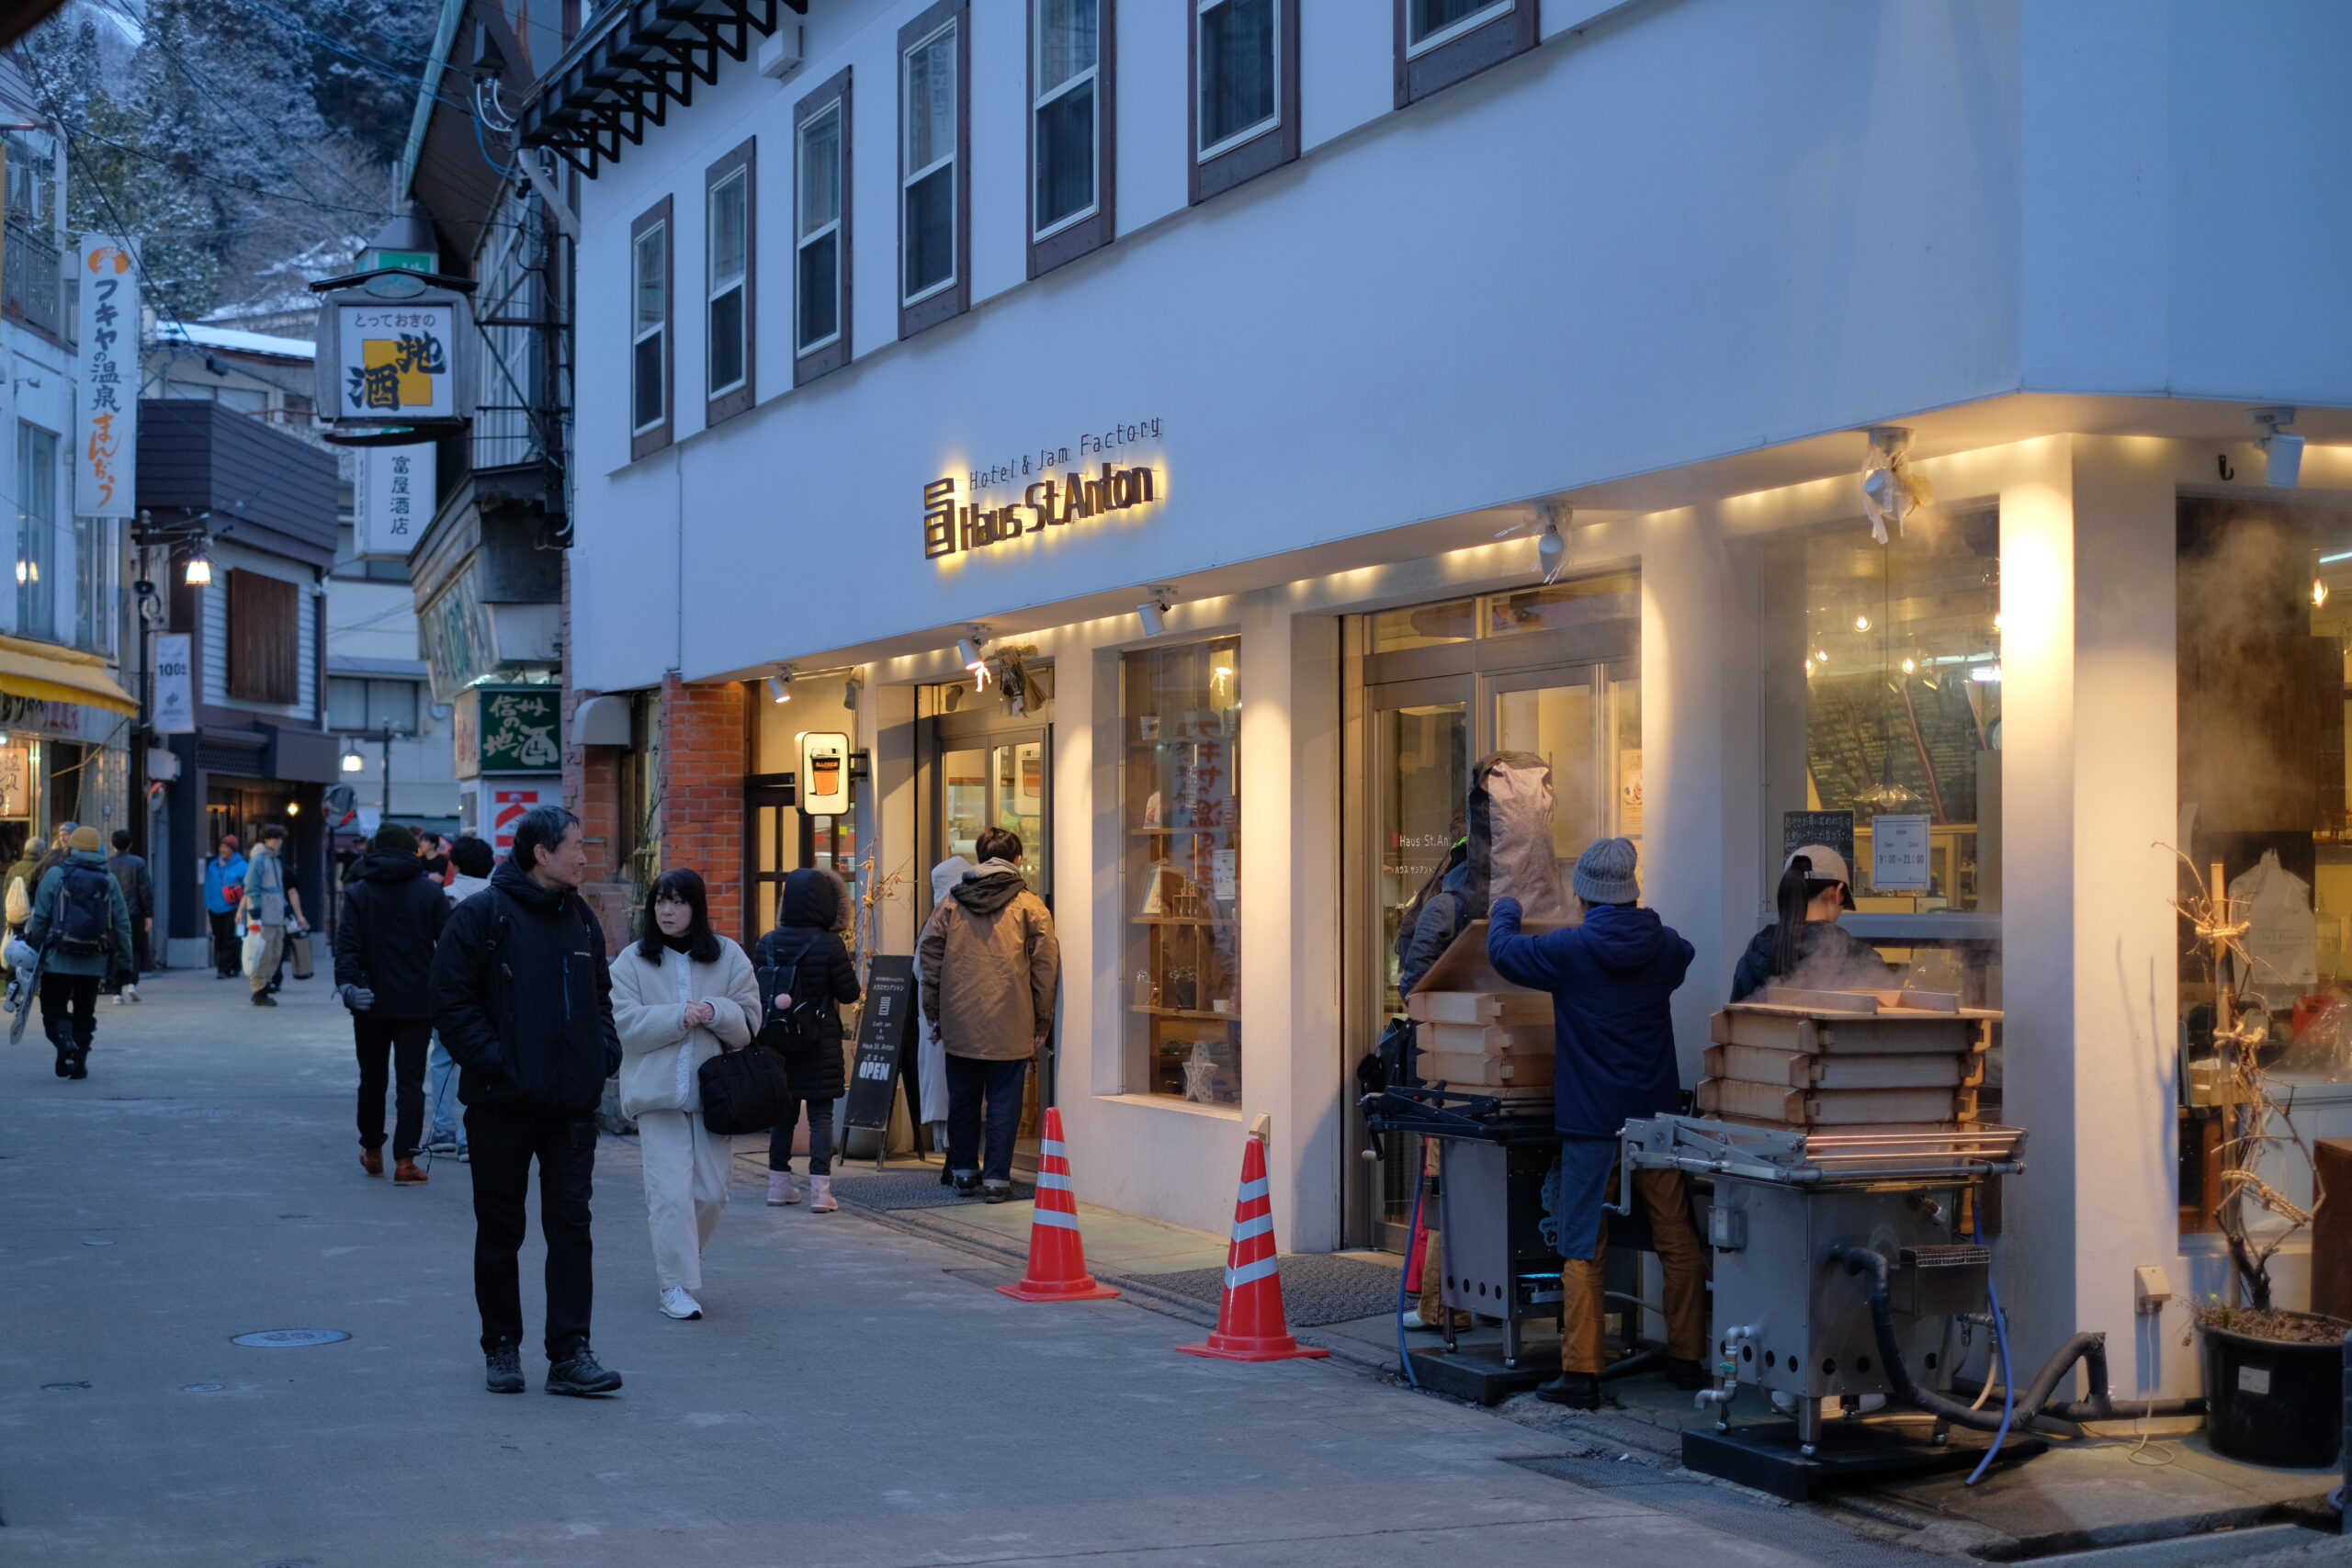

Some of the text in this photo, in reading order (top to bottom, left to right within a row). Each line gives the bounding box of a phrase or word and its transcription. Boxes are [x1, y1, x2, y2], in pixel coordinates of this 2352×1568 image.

[355, 313, 435, 328] とっておきの
[969, 416, 1159, 491] Hotel & Jam Factory
[390, 455, 412, 536] 富屋酒店
[959, 502, 1023, 551] Haus
[1399, 834, 1420, 847] Haus
[1395, 865, 1409, 874] ハウス
[858, 1060, 890, 1081] OPEN
